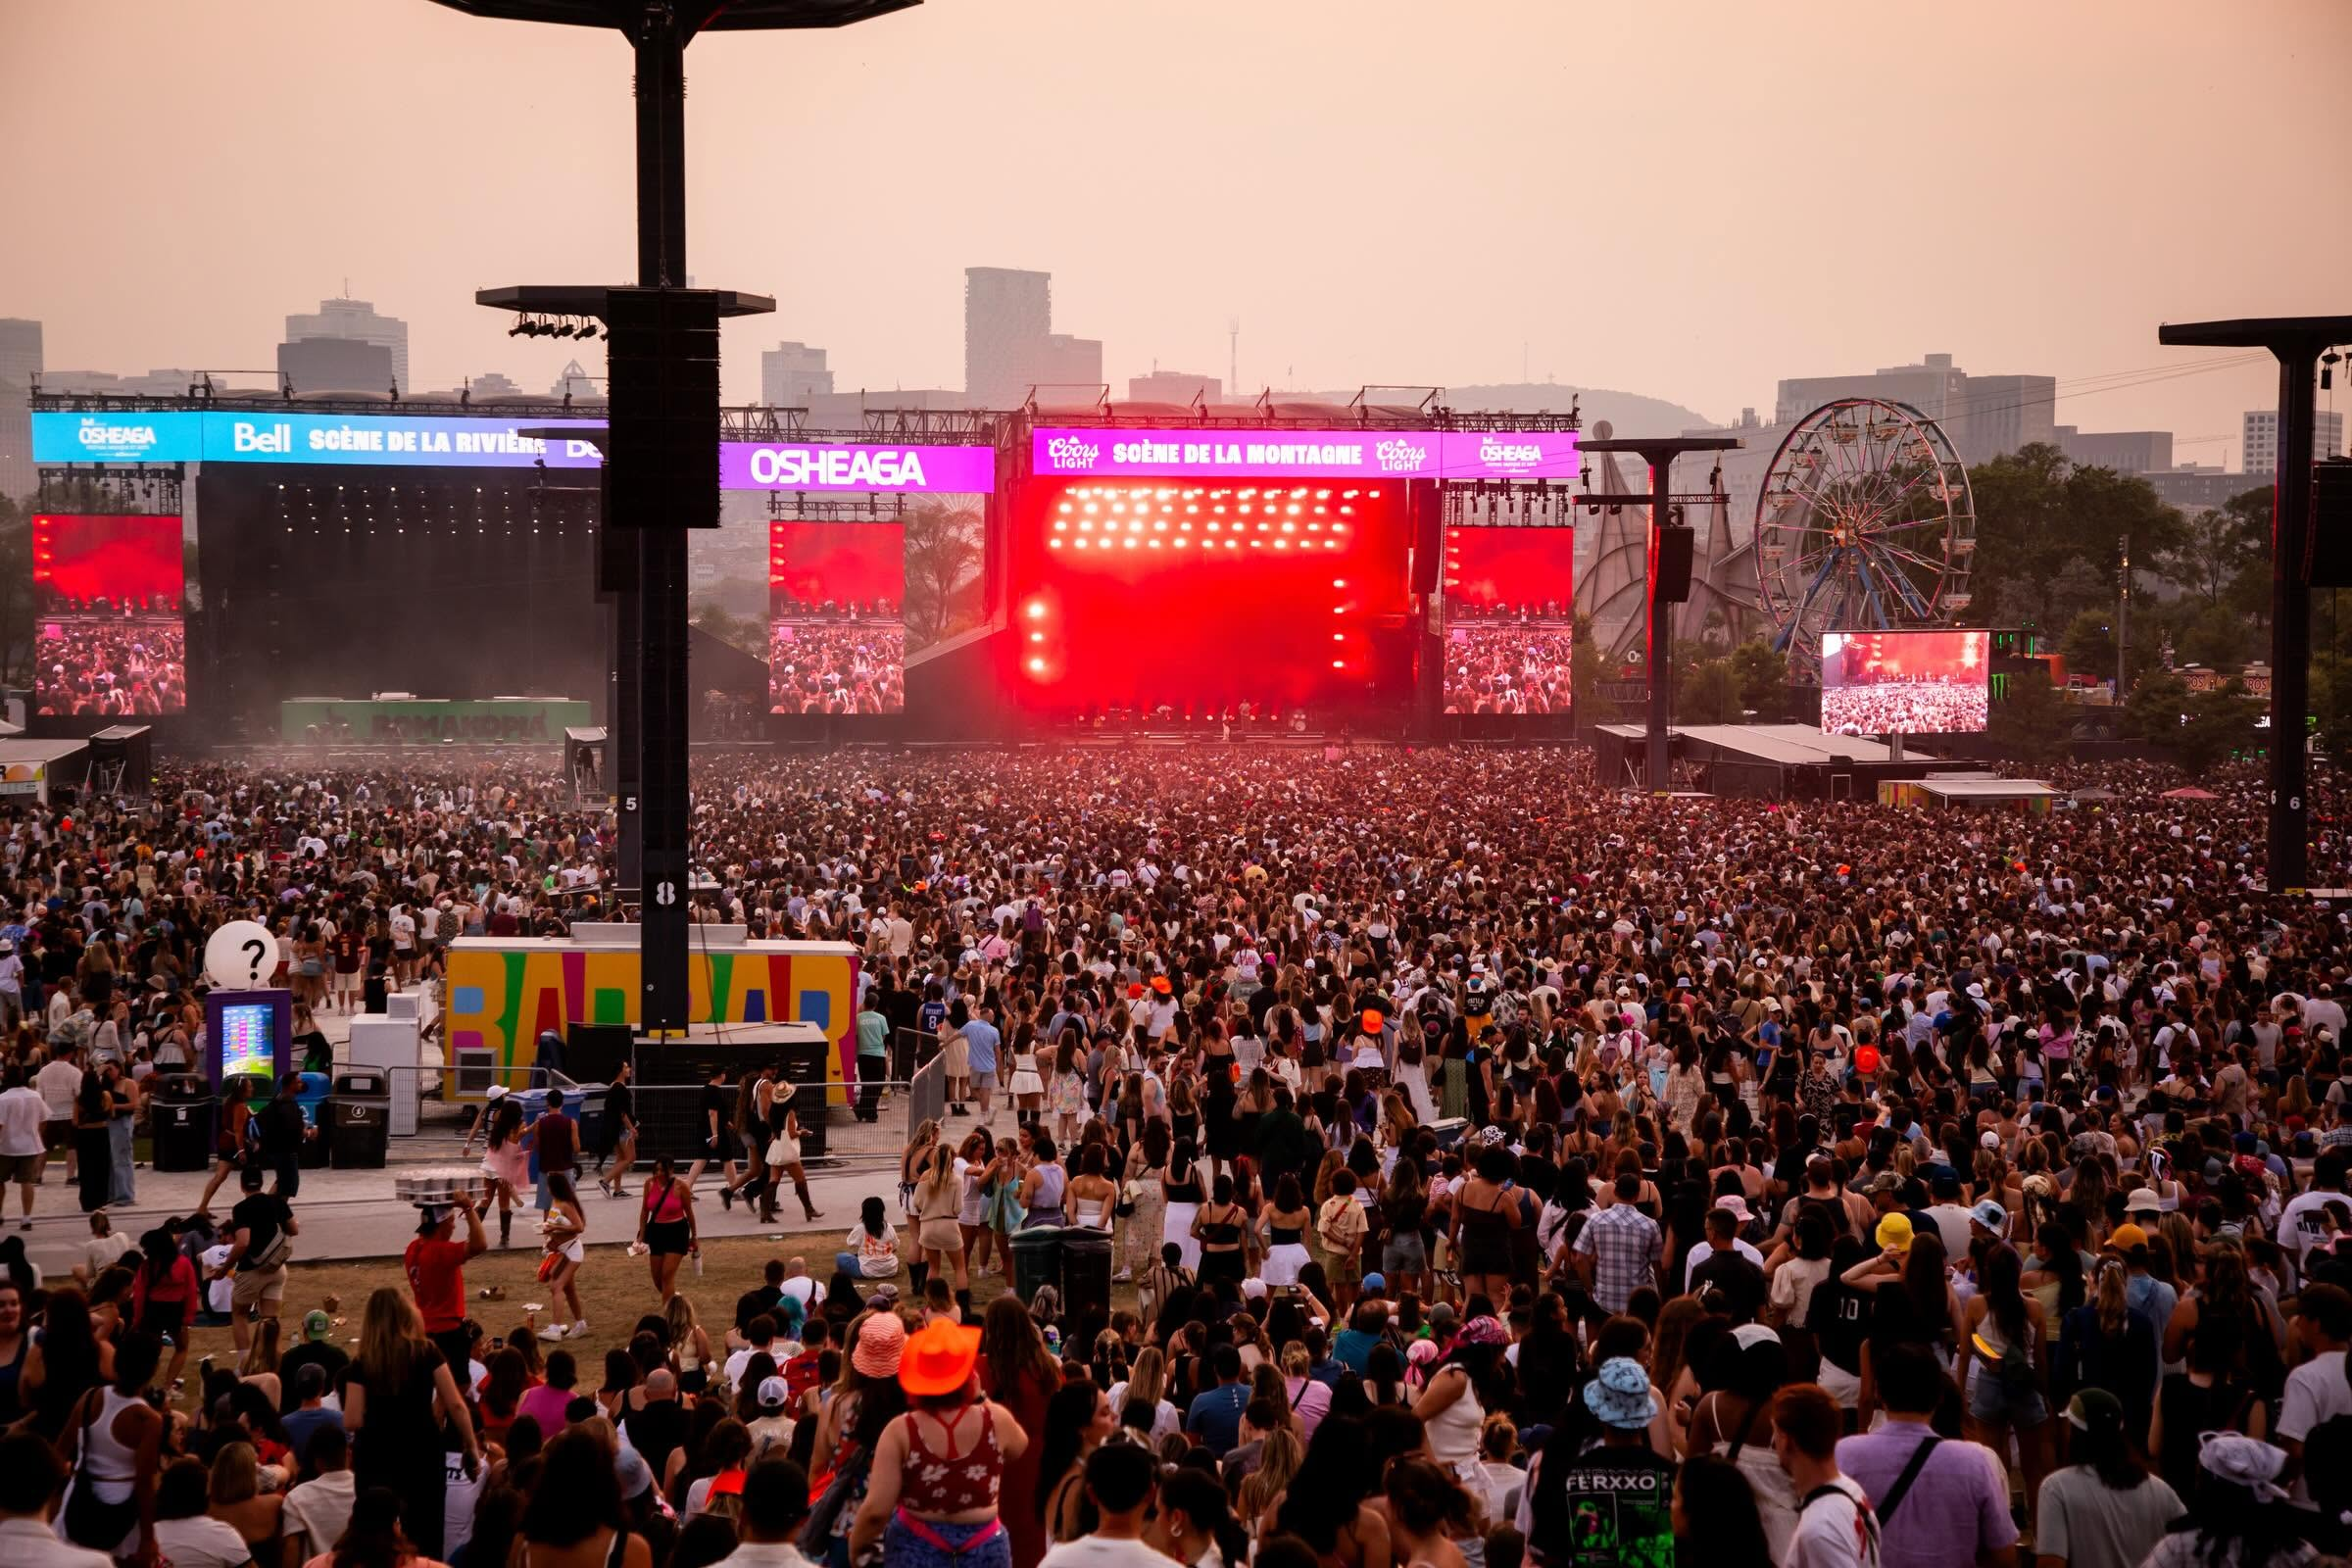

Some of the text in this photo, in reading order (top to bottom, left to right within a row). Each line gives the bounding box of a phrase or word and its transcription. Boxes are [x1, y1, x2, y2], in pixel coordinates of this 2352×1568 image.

[79, 426, 157, 445] OSHEAGA
[234, 422, 291, 453] Bell
[309, 425, 383, 452] SCÈNE
[387, 431, 416, 452] DE
[421, 431, 452, 453] LA
[456, 428, 548, 454] RIVIÈRE
[1048, 437, 1100, 459] Coors
[1112, 439, 1363, 465] SCÈNE DE LA MONTAGNE
[1375, 440, 1427, 461] Coors
[1480, 445, 1544, 462] OSHEAGA
[750, 448, 927, 486] OSHEAGA
[1054, 458, 1095, 468] LIGHT
[1382, 460, 1421, 471] LIGHT
[625, 797, 637, 811] 5
[2271, 790, 2277, 805] 6
[2289, 796, 2301, 809] 6
[656, 882, 676, 906] 8
[241, 939, 266, 980] ?
[928, 1015, 937, 1029] 8
[1566, 1474, 1657, 1492] FERXXO
